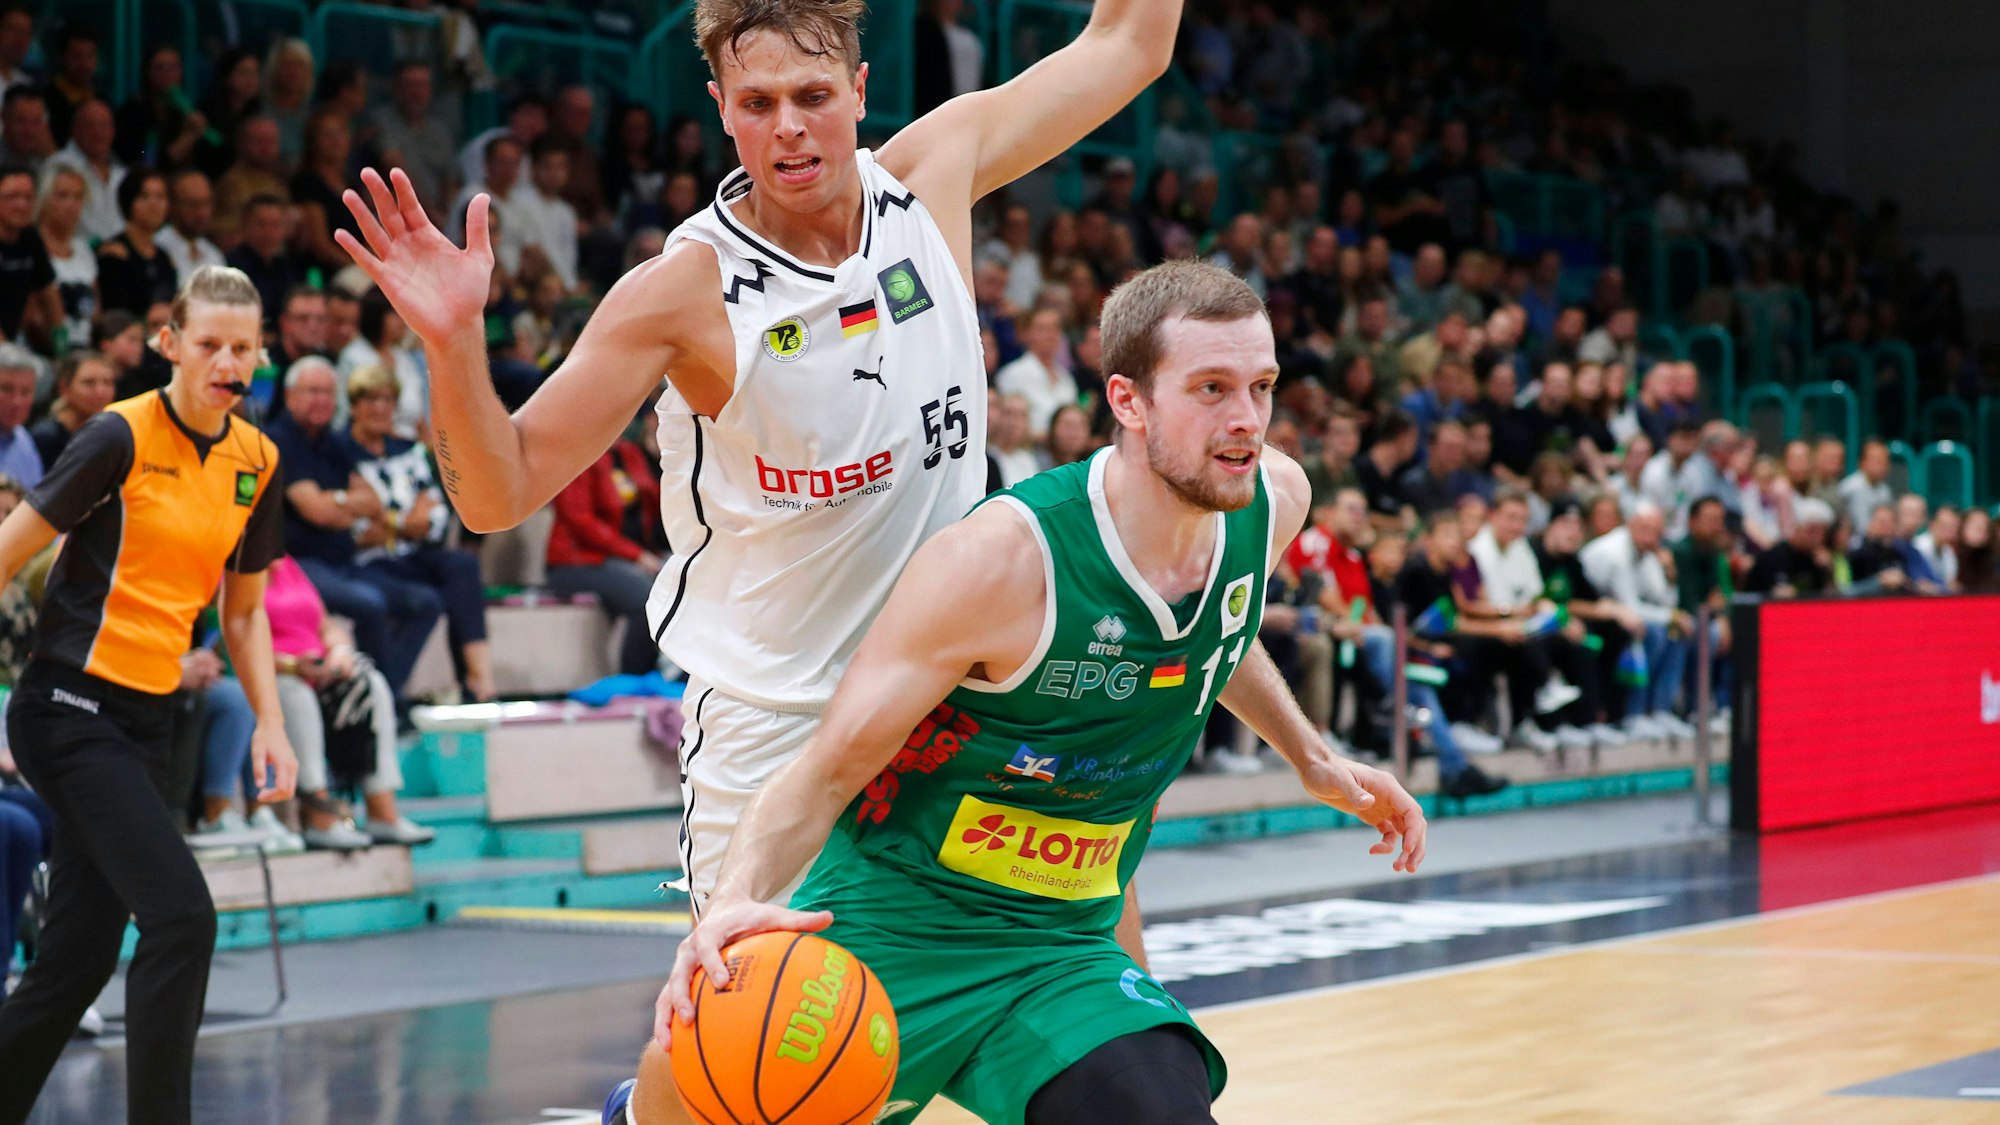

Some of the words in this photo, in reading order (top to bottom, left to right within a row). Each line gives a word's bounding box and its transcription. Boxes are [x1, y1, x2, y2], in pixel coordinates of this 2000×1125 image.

[894, 297, 929, 320] BARMER
[919, 385, 970, 471] 55
[754, 449, 893, 498] brose
[762, 495, 802, 511] Technik
[1035, 660, 1139, 701] EPG
[1194, 635, 1246, 716] 11
[1073, 755, 1098, 772] VR
[1016, 825, 1119, 870] LOTTO
[776, 945, 849, 1065] Wilson
